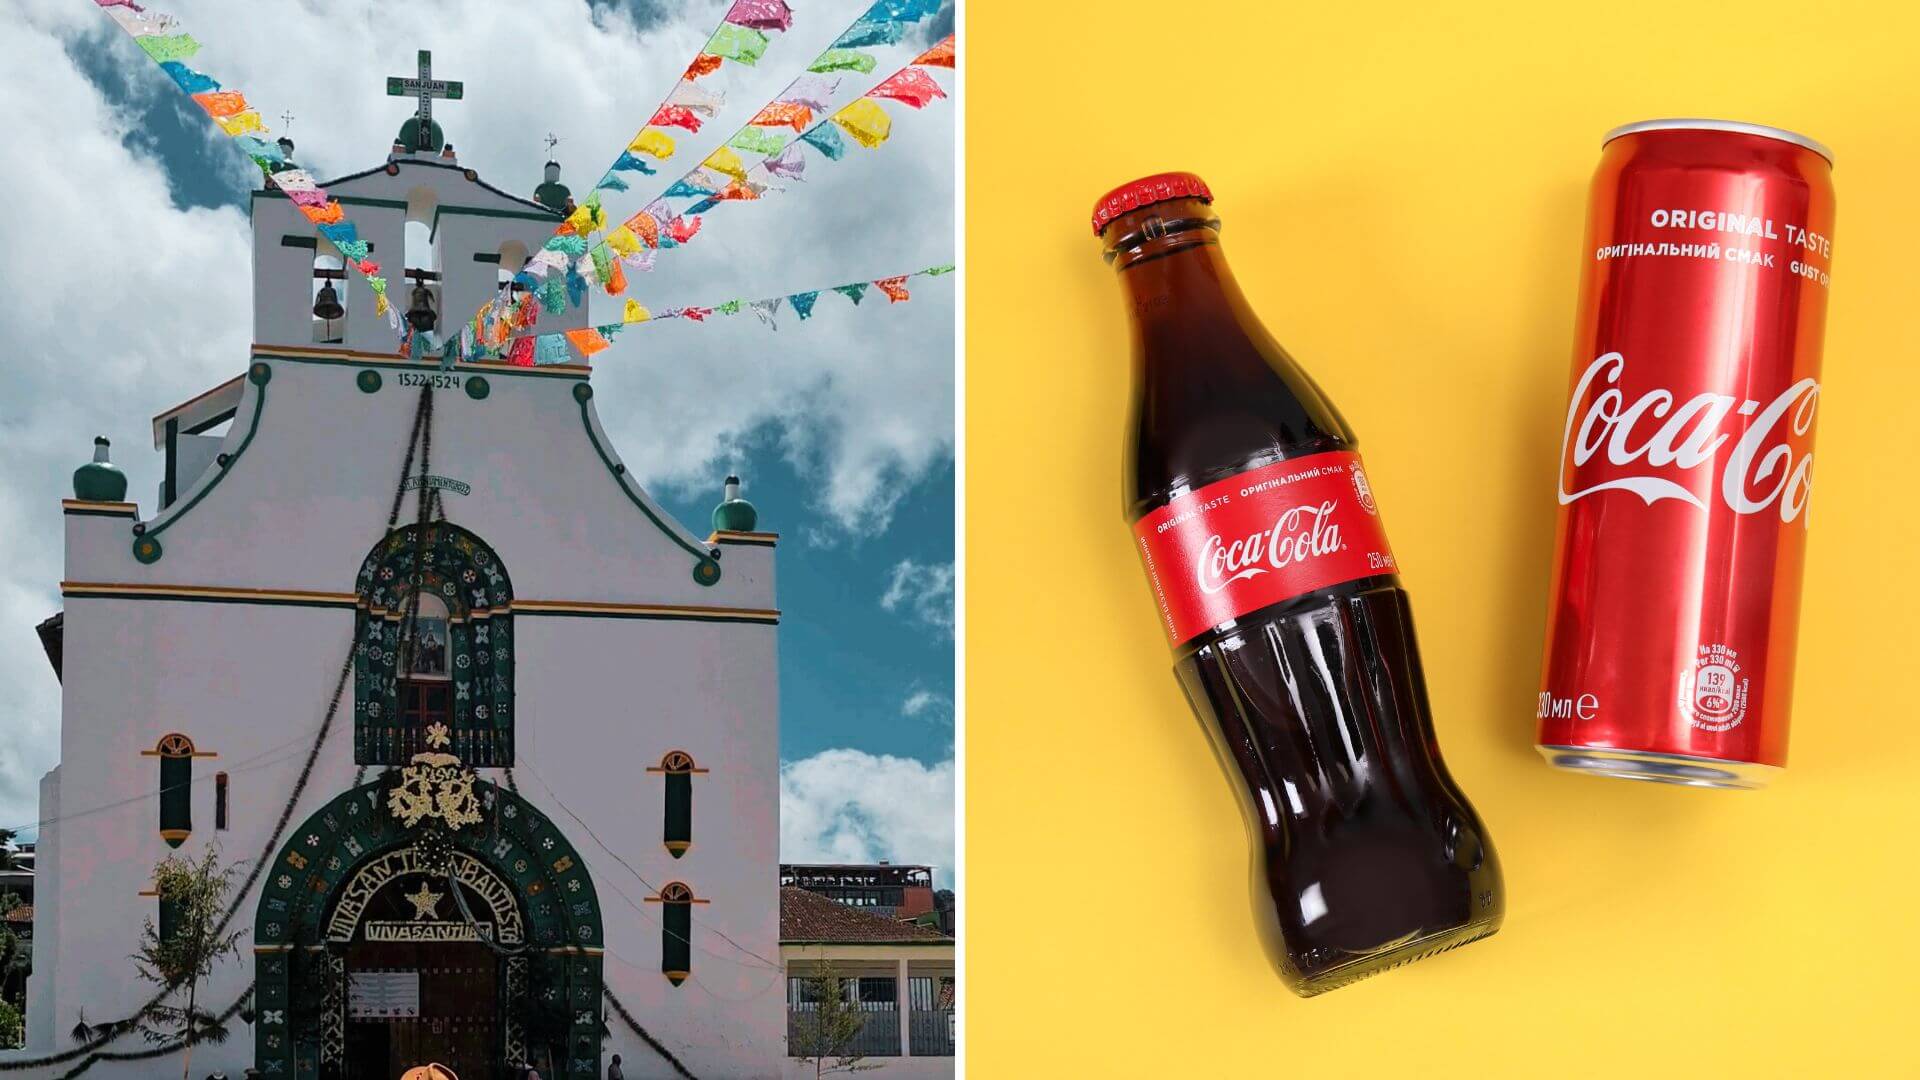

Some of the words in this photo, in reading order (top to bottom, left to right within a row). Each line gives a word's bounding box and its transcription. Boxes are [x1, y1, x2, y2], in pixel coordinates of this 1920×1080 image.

[1651, 209, 1778, 240] ORIGINAL
[1785, 223, 1830, 259] TASTE
[1596, 242, 1721, 260] ОРИГІНАЛЬНИЙ
[1724, 247, 1775, 268] СМАК
[1790, 260, 1819, 281] GUST
[398, 373, 426, 387] 1522
[431, 375, 460, 389] 1524
[1557, 351, 1821, 532] Coca-Co
[1240, 467, 1320, 498] ОРИГІНАЛЬНИЙ
[1321, 464, 1344, 475] СМАК
[1199, 494, 1230, 514] TASTE
[1197, 498, 1342, 595] Coca-Cola
[1708, 672, 1726, 687] 139
[1552, 698, 1572, 719] мл
